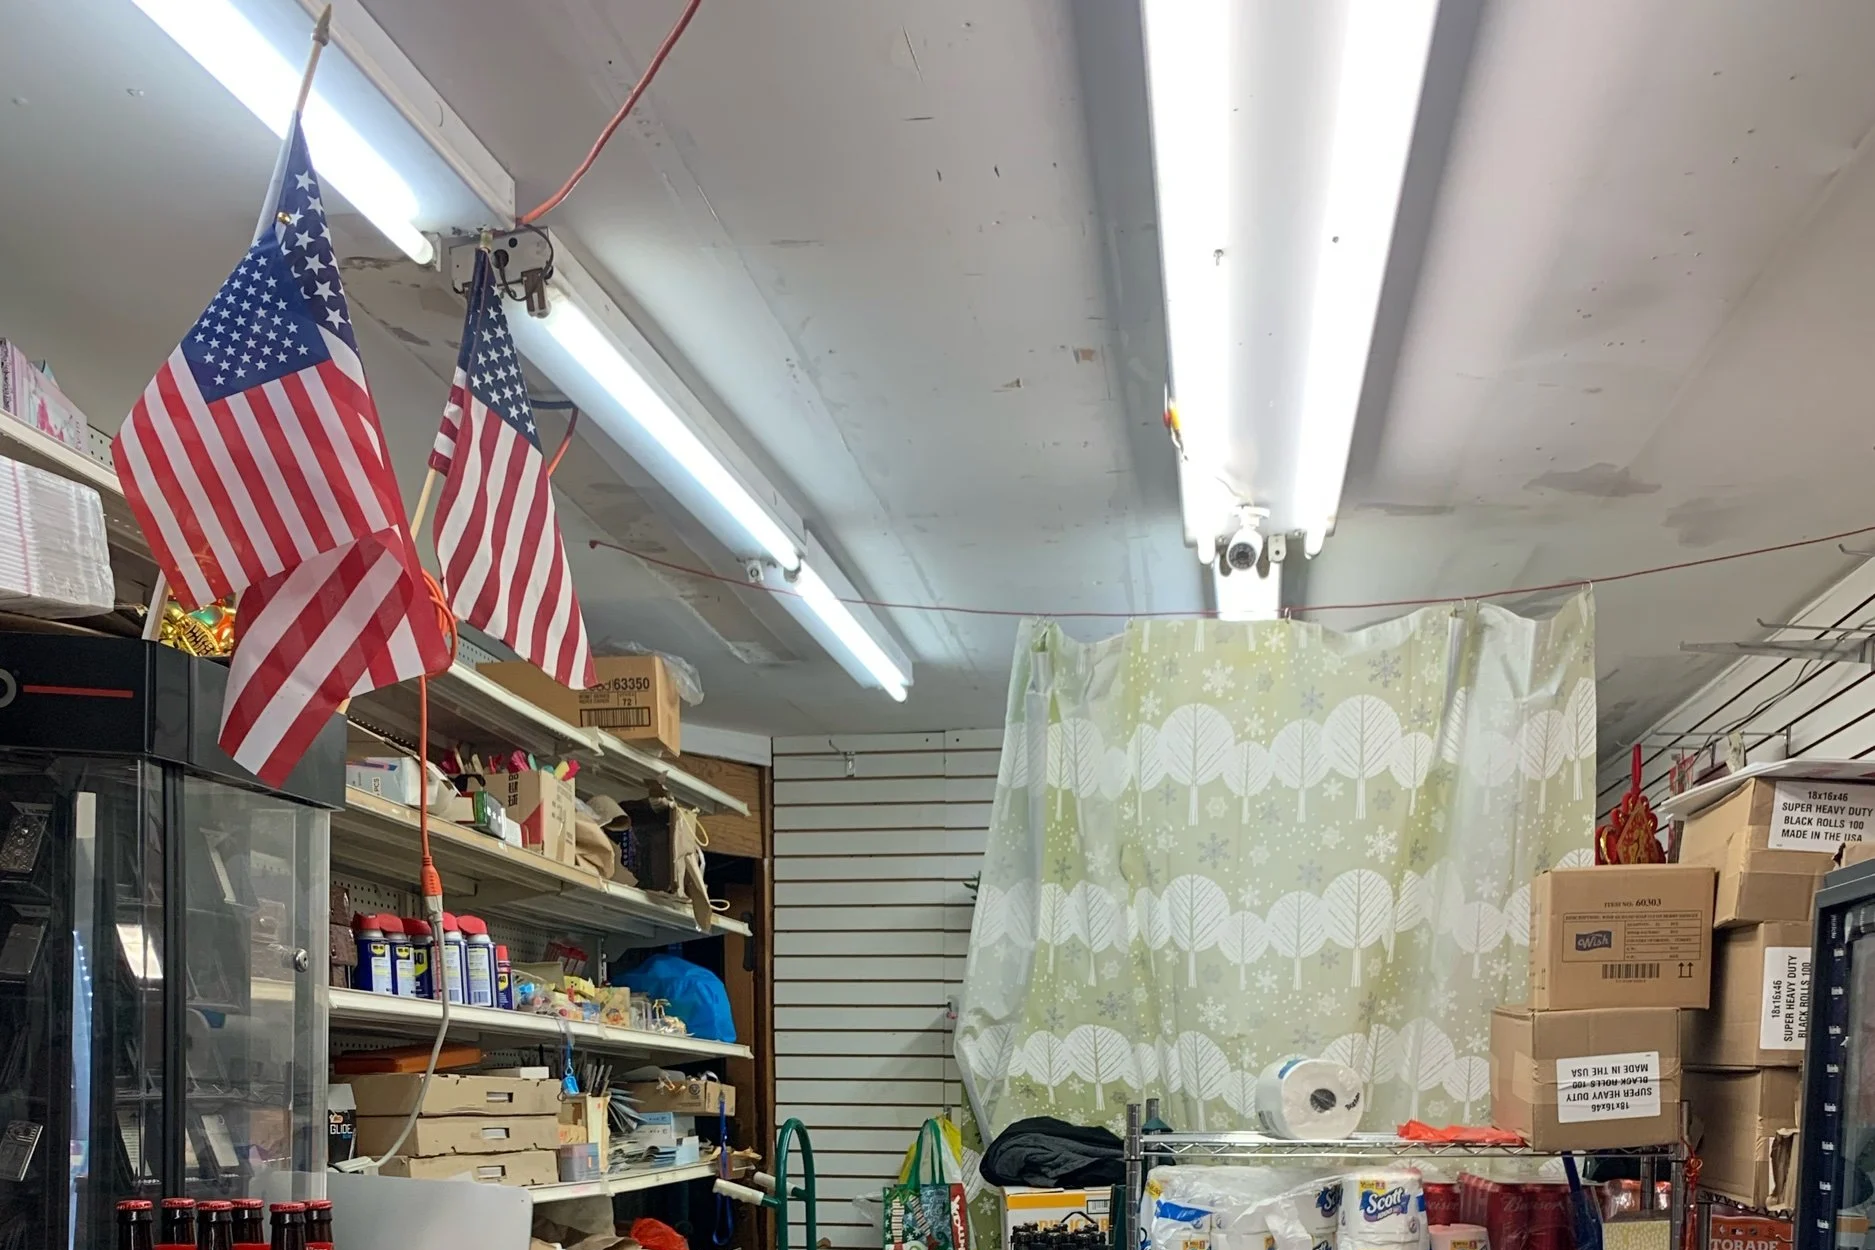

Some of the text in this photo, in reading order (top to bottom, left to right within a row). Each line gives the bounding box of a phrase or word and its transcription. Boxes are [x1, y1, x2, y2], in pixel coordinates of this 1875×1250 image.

[614, 677, 650, 690] 63350
[1807, 791, 1849, 802] 18x16x46
[1782, 802, 1873, 817] SUPER HEAVY DUTY
[1784, 815, 1864, 830] BLACK ROLLS 100
[1781, 829, 1862, 842] MADE IN THE USA
[1771, 980, 1782, 1018] 18x16x46
[1784, 955, 1797, 1042] SUPER HEAVY DUTY
[1800, 980, 1809, 1008] ROLLS
[1798, 1011, 1808, 1038] BLACK
[1571, 1063, 1648, 1078] MADE IN THE USA
[1566, 1087, 1652, 1102] SUPER HEAVY DUTY
[1591, 1102, 1630, 1112] 18x16x46
[1366, 1186, 1404, 1214] Scott
